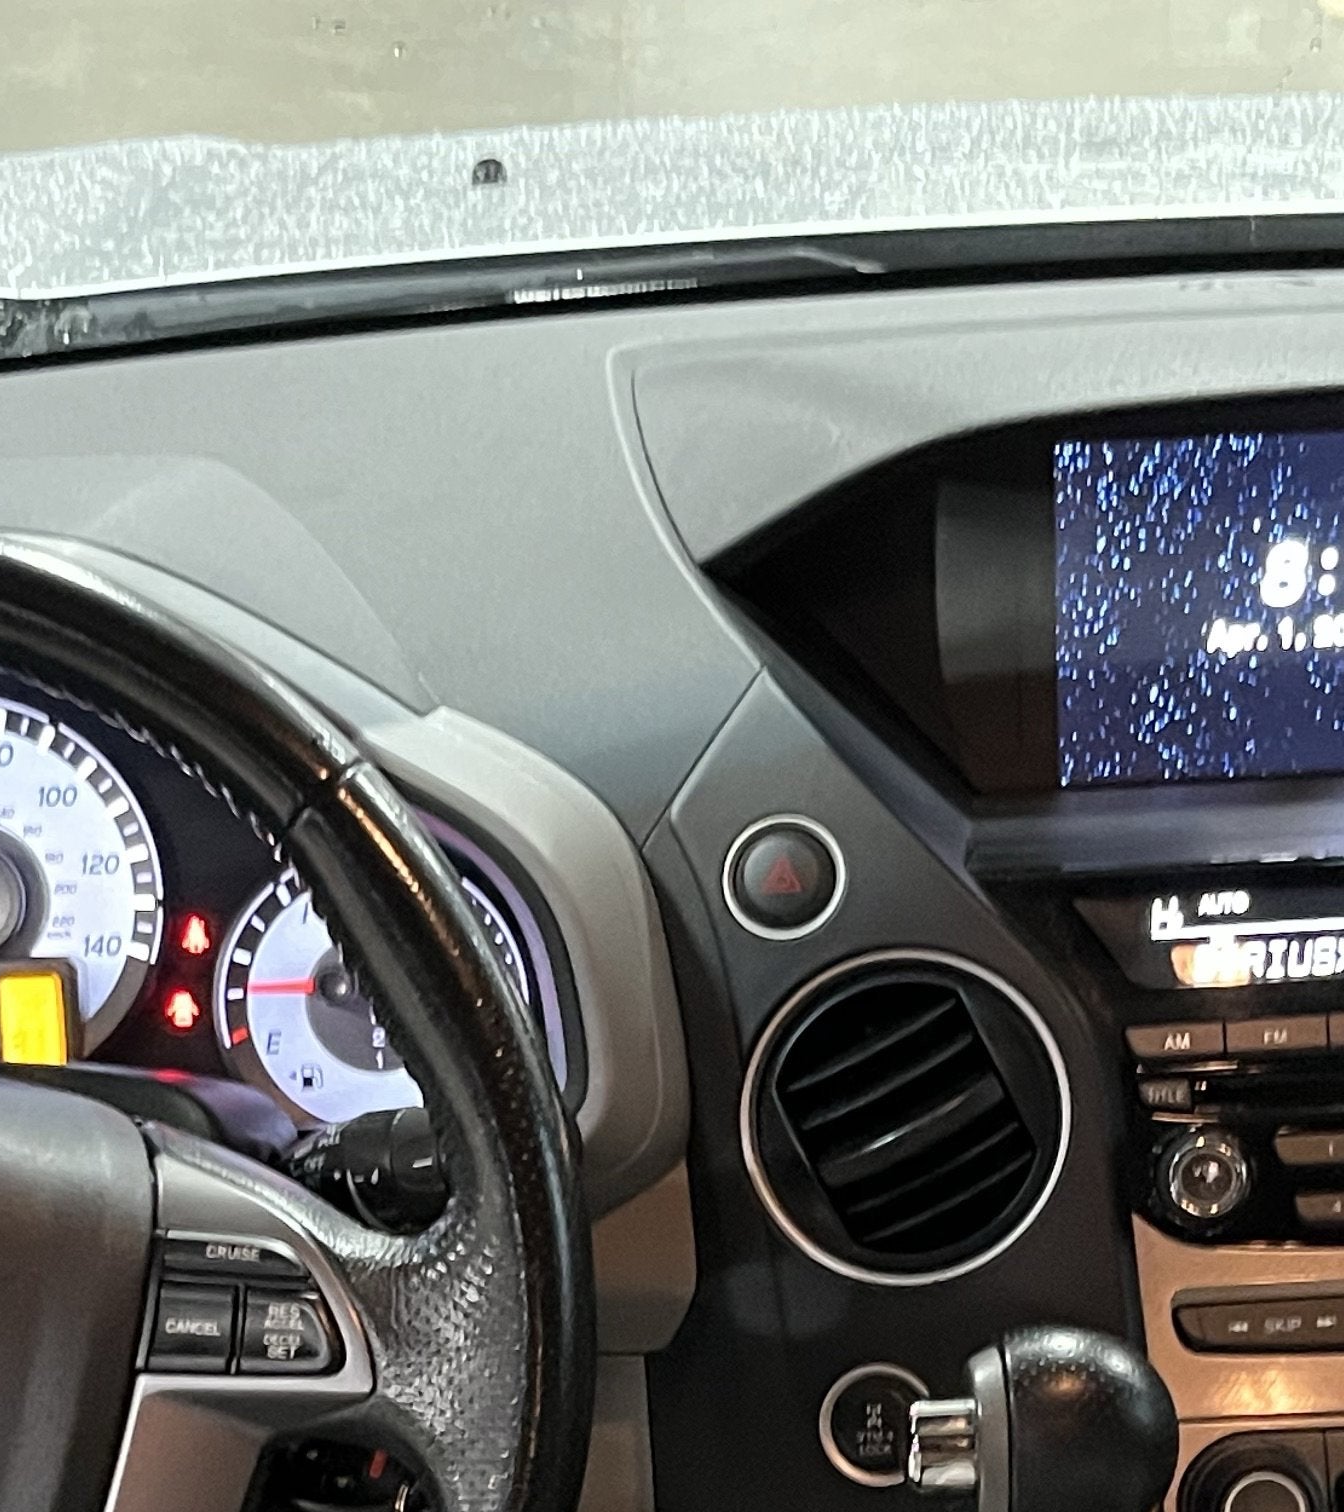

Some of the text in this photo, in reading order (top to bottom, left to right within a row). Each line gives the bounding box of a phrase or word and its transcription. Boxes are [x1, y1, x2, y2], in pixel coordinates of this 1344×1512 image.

[38, 785, 79, 808] 100
[82, 853, 120, 876] 120
[1198, 890, 1250, 917] AUTO
[84, 934, 122, 957] 140
[267, 1031, 282, 1055] E
[1164, 1032, 1191, 1050] AM
[1263, 1029, 1288, 1045] FM
[206, 1245, 260, 1262] CRUISE
[268, 1304, 301, 1319] RES
[165, 1318, 221, 1336] CANCEL
